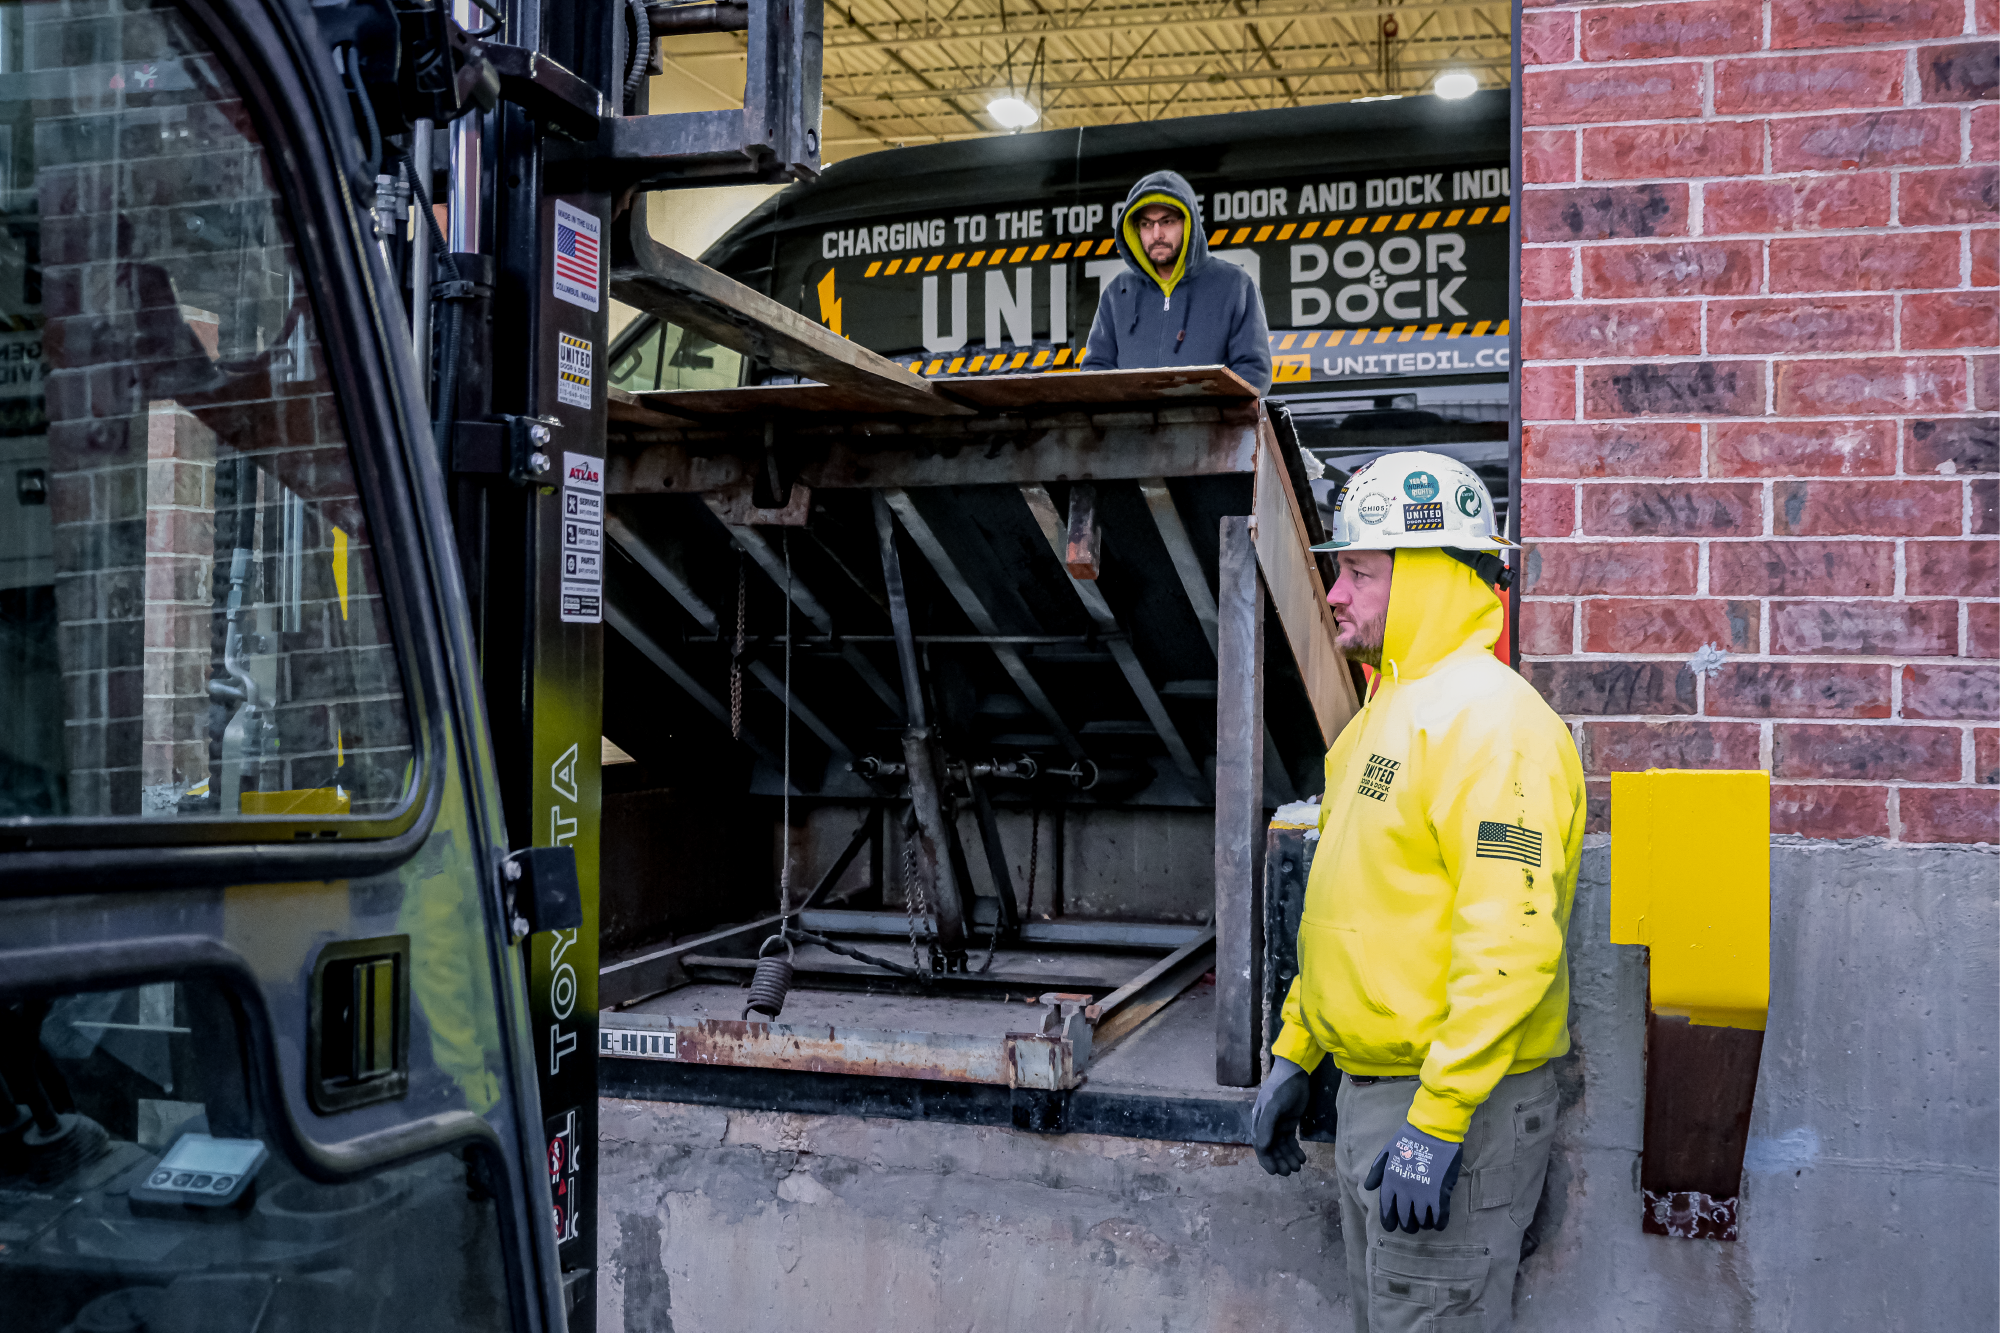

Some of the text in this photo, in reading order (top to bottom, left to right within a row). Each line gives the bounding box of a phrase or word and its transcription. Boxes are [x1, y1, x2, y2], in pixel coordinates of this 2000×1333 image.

[822, 218, 945, 260] CHARGING
[954, 215, 987, 245] TO
[995, 209, 1043, 241] THE
[1052, 204, 1103, 236] TOP
[1213, 187, 1288, 222] DOOR
[1297, 181, 1357, 215] AND
[1366, 173, 1443, 210] DOCK
[1290, 233, 1467, 283] DOOR
[1369, 268, 1388, 289] &
[1291, 276, 1469, 327] DOCK
[560, 345, 591, 368] UNITED
[568, 467, 599, 483] ATLAS
[1406, 509, 1442, 520] UNITED
[1363, 763, 1395, 785] UNITED
[550, 742, 578, 1076] TOYTA
